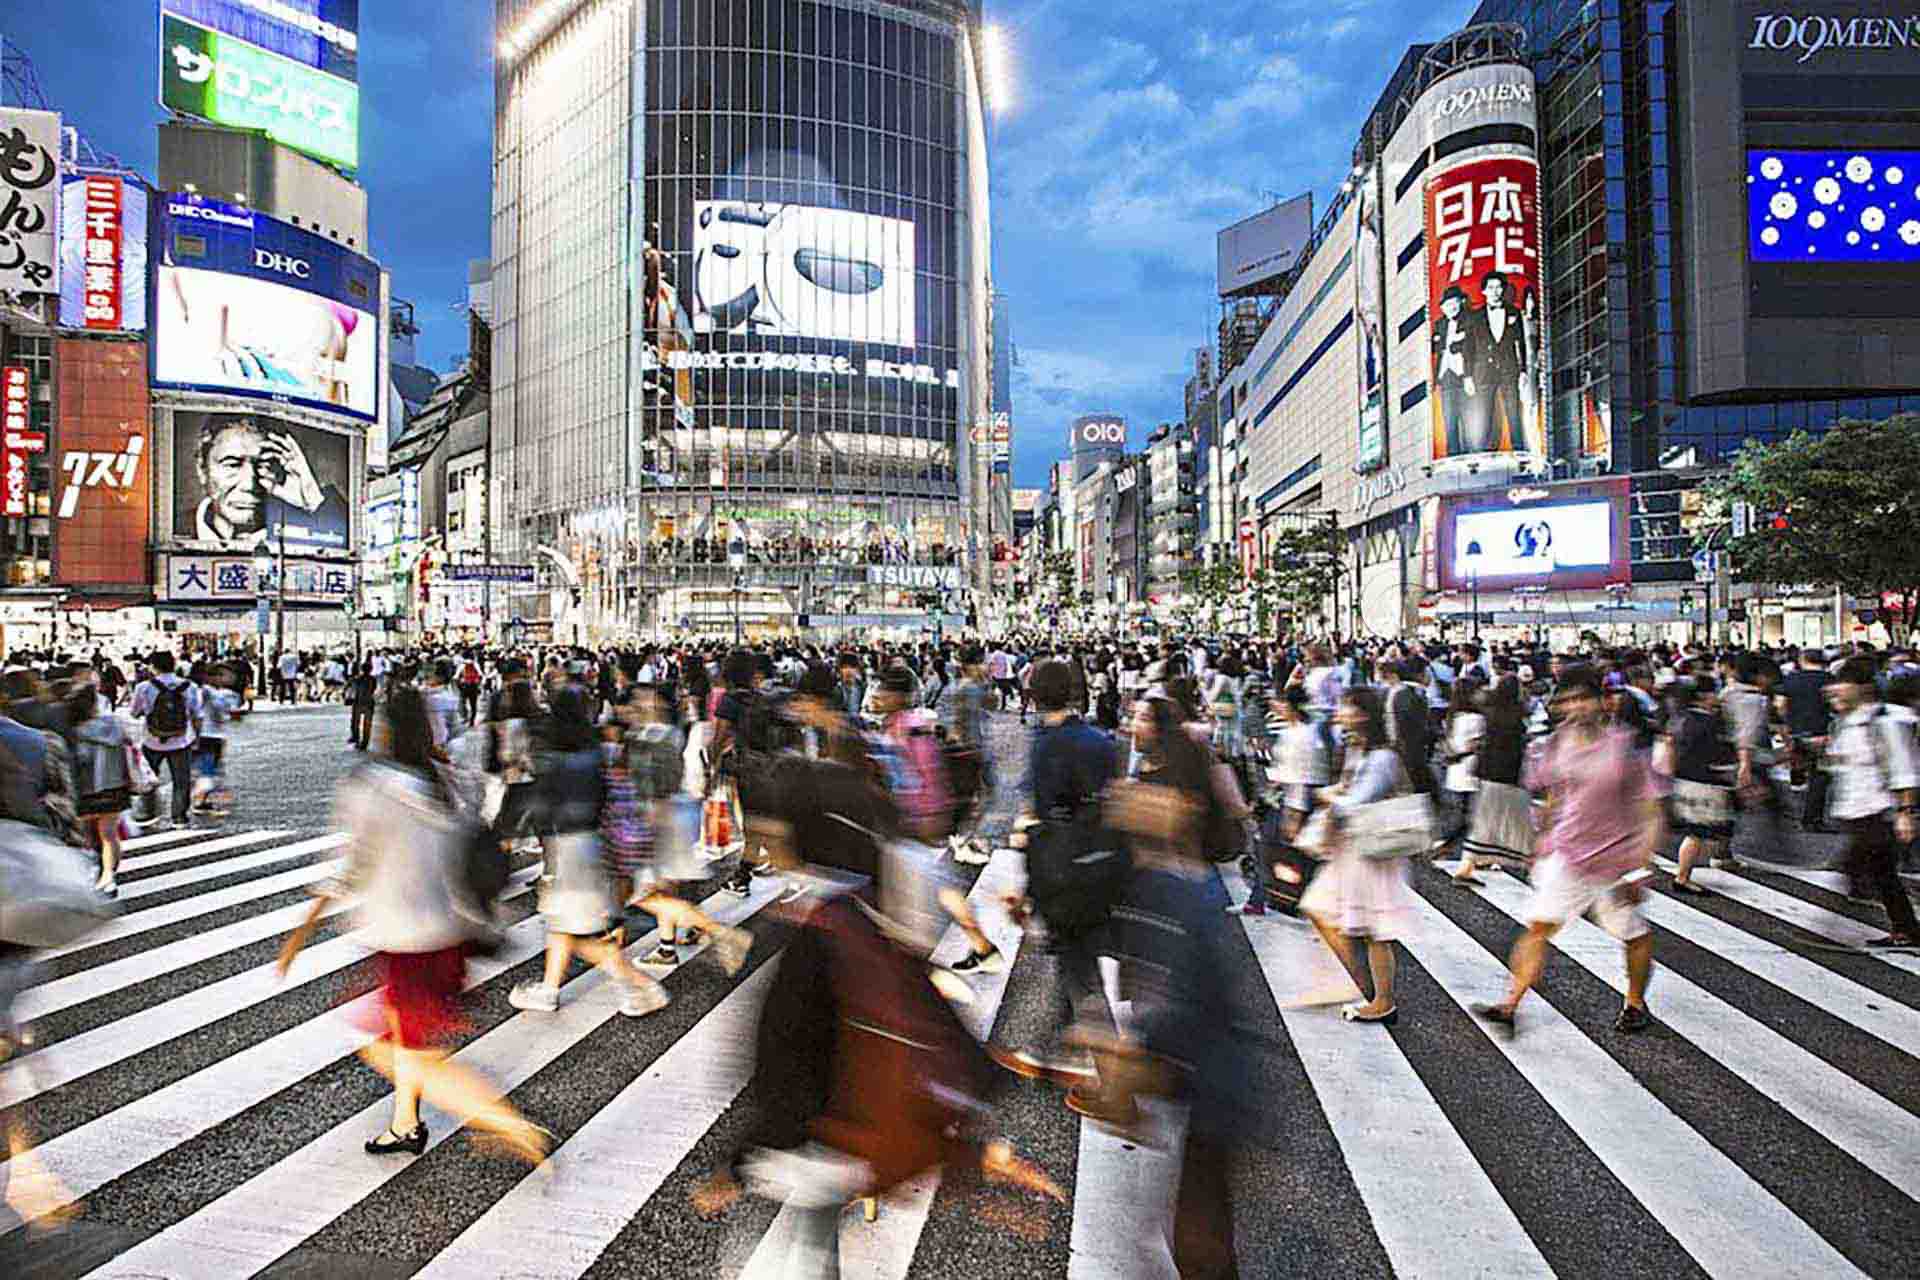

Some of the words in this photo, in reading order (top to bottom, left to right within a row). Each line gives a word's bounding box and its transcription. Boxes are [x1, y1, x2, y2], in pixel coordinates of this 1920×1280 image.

[1434, 176, 1523, 240] 日本
[255, 248, 311, 279] DHC
[1438, 226, 1537, 283] ダービー
[57, 435, 145, 518] クスリ
[868, 566, 960, 587] TSUTAYA
